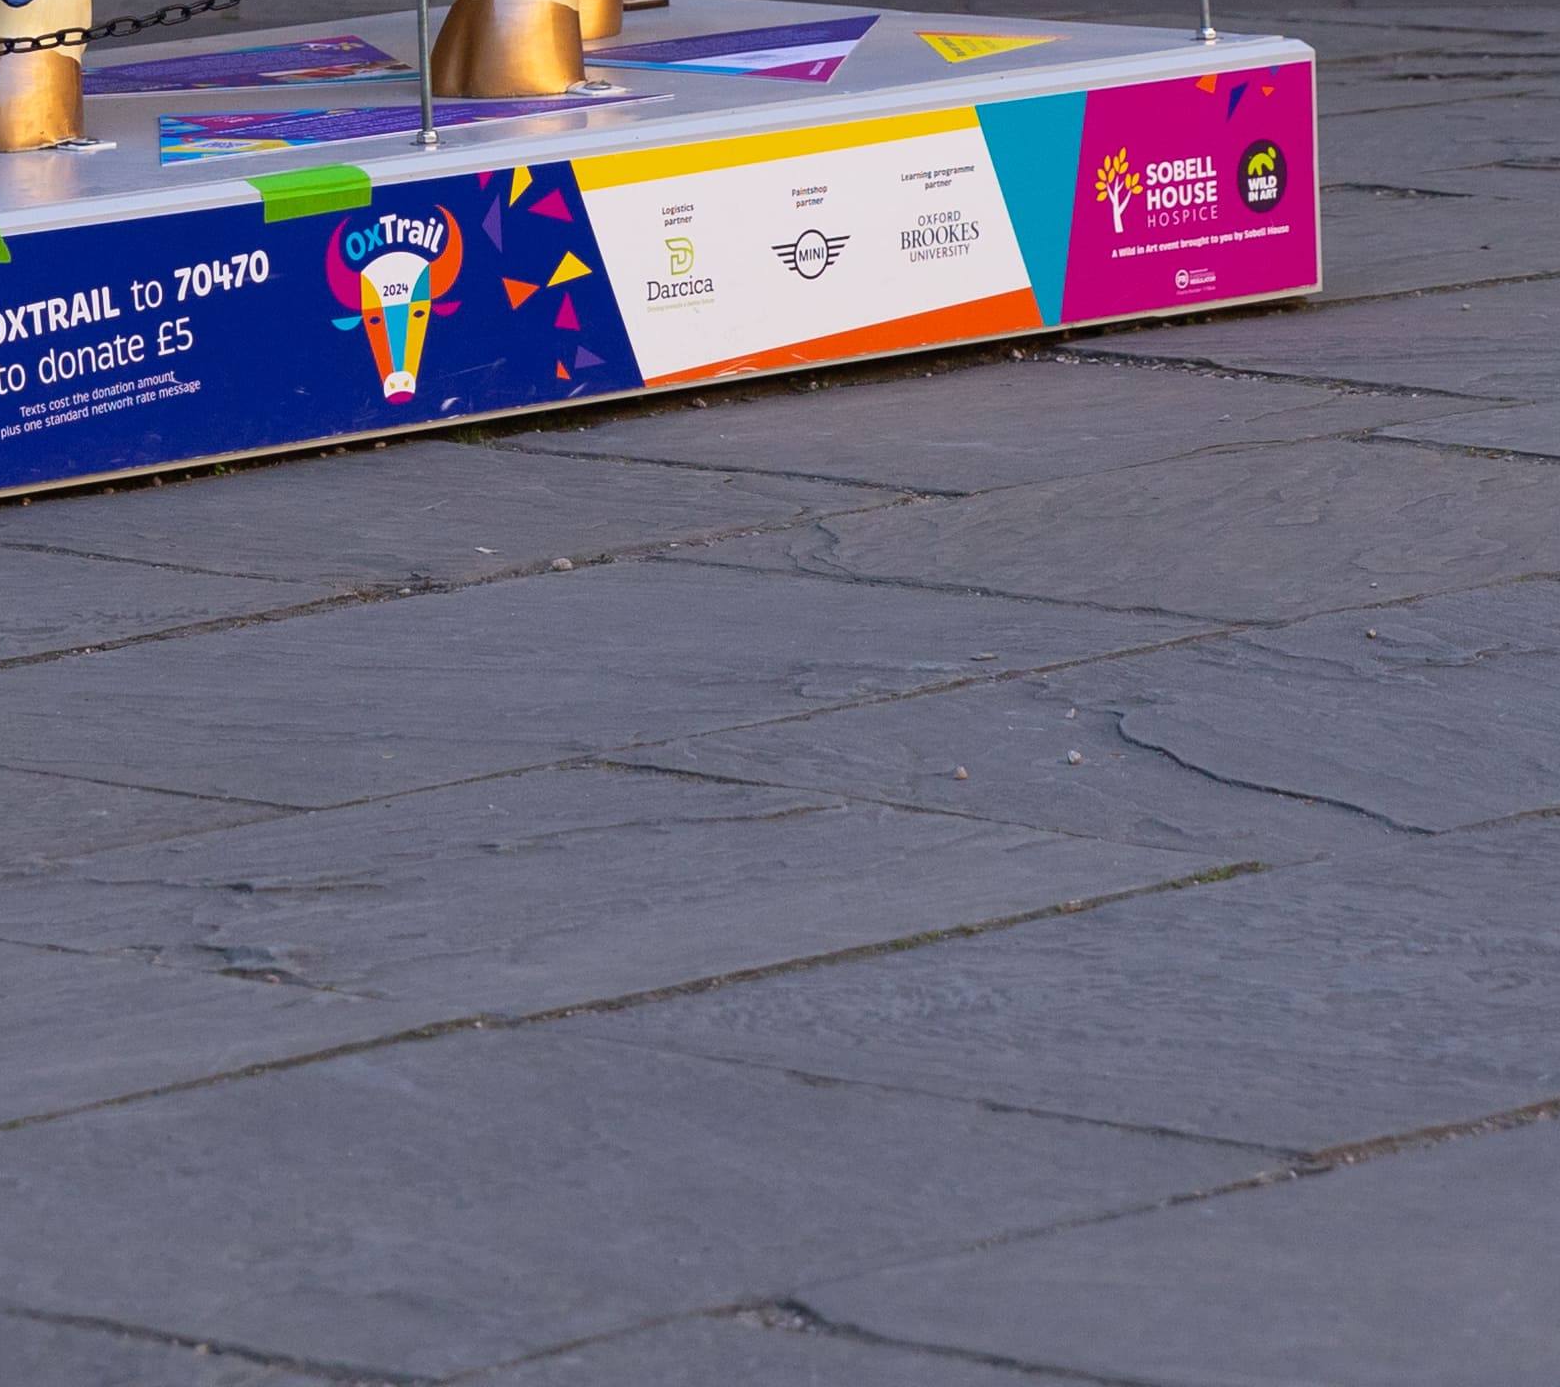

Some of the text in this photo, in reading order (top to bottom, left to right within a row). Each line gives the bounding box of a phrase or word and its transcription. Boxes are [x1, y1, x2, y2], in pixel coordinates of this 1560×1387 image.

[901, 165, 975, 183] Learning programme
[1146, 156, 1217, 186] SOBELL
[792, 184, 828, 198] Paintshop
[925, 177, 952, 190] partner
[1248, 175, 1277, 191] WILD
[796, 196, 824, 208] partner
[1147, 180, 1218, 211] HOUSE
[1248, 188, 1278, 202] IN ART
[662, 202, 694, 217] Logistics
[918, 210, 961, 227] OXFORD
[1147, 205, 1218, 228] HOSPICE
[664, 214, 692, 227] partner
[346, 213, 444, 261] OxTrail
[901, 221, 980, 251] BROOKES
[1112, 225, 1290, 258] A Wild in Art event brought to you by Sobell House
[799, 247, 825, 263] MINI
[910, 243, 970, 263] UNIVERSITY
[131, 280, 163, 312] to
[174, 250, 270, 301] 70470
[383, 283, 409, 297] 2024
[646, 275, 714, 302] Darcica
[38, 333, 144, 385] donate
[156, 317, 193, 356] £5
[19, 370, 176, 418] Texts cost the donation amount
[0, 379, 201, 441] plus one standard network rate message
